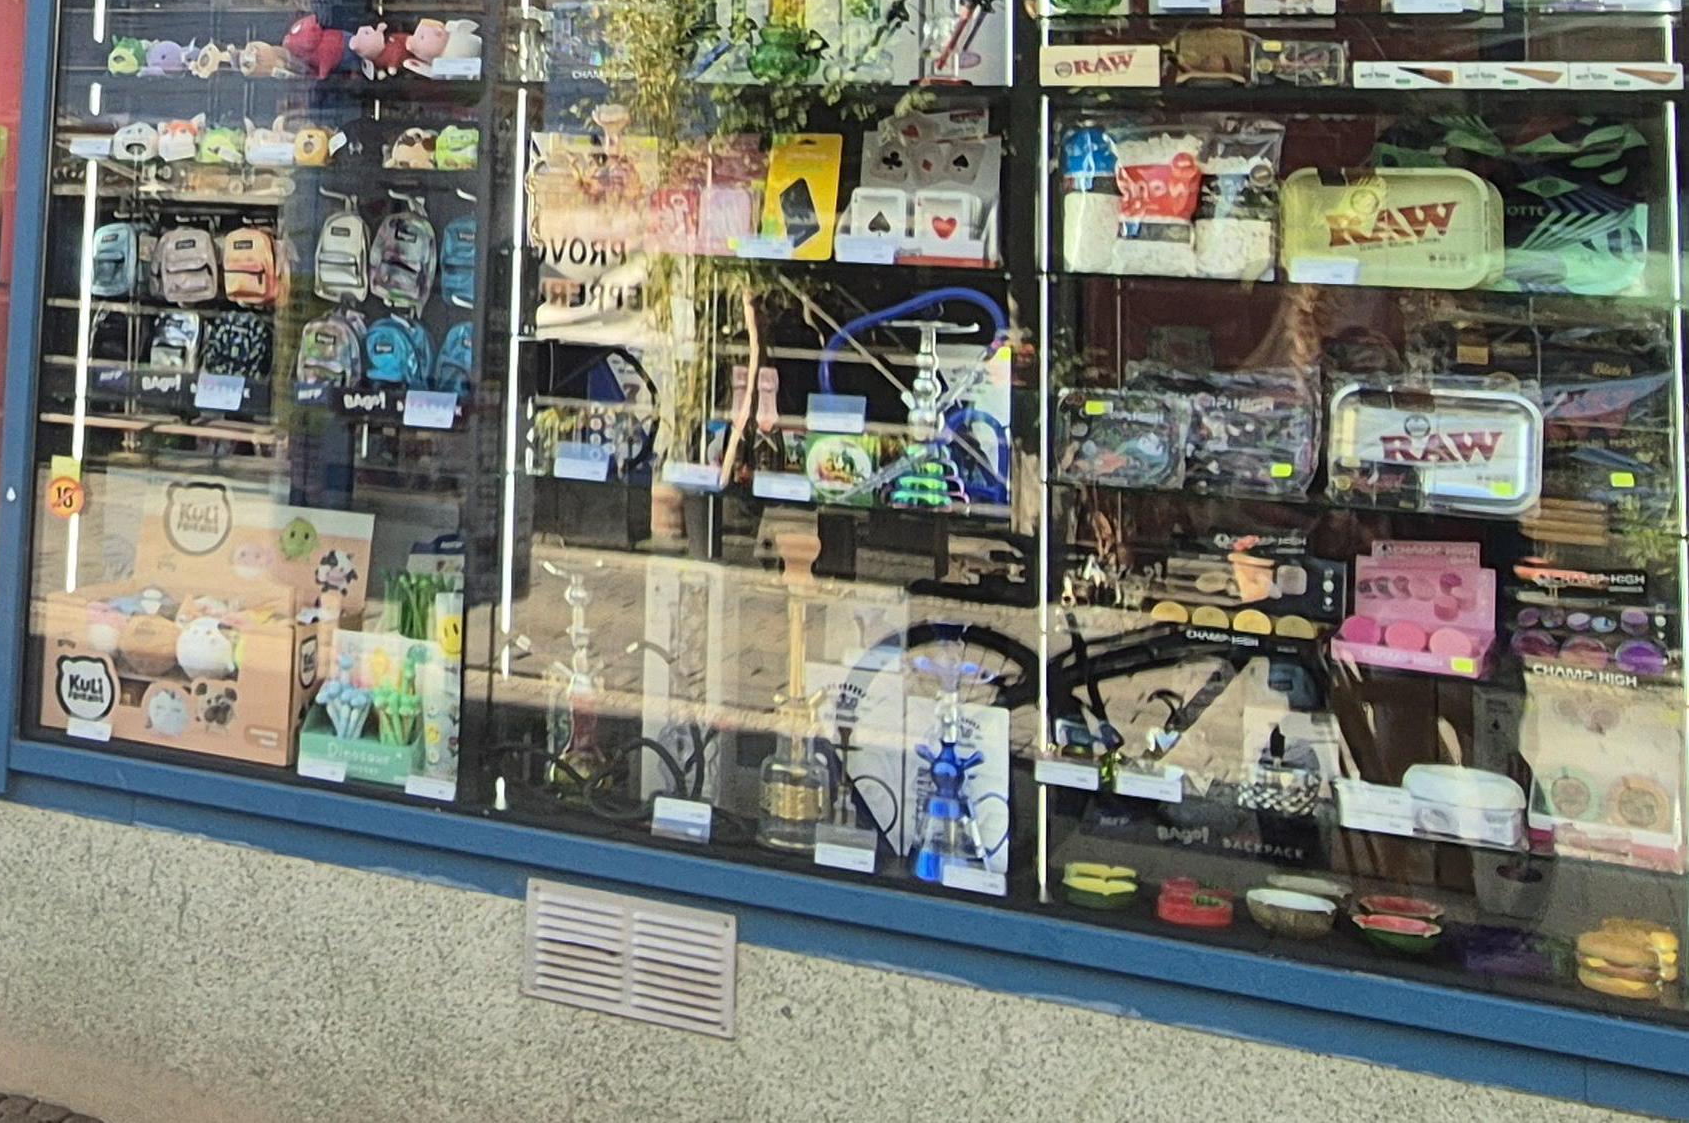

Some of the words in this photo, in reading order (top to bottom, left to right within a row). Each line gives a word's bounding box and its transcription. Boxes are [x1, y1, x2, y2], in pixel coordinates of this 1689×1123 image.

[1074, 53, 1133, 76] RAW
[1325, 202, 1458, 248] RAW
[1380, 432, 1503, 463] RAW
